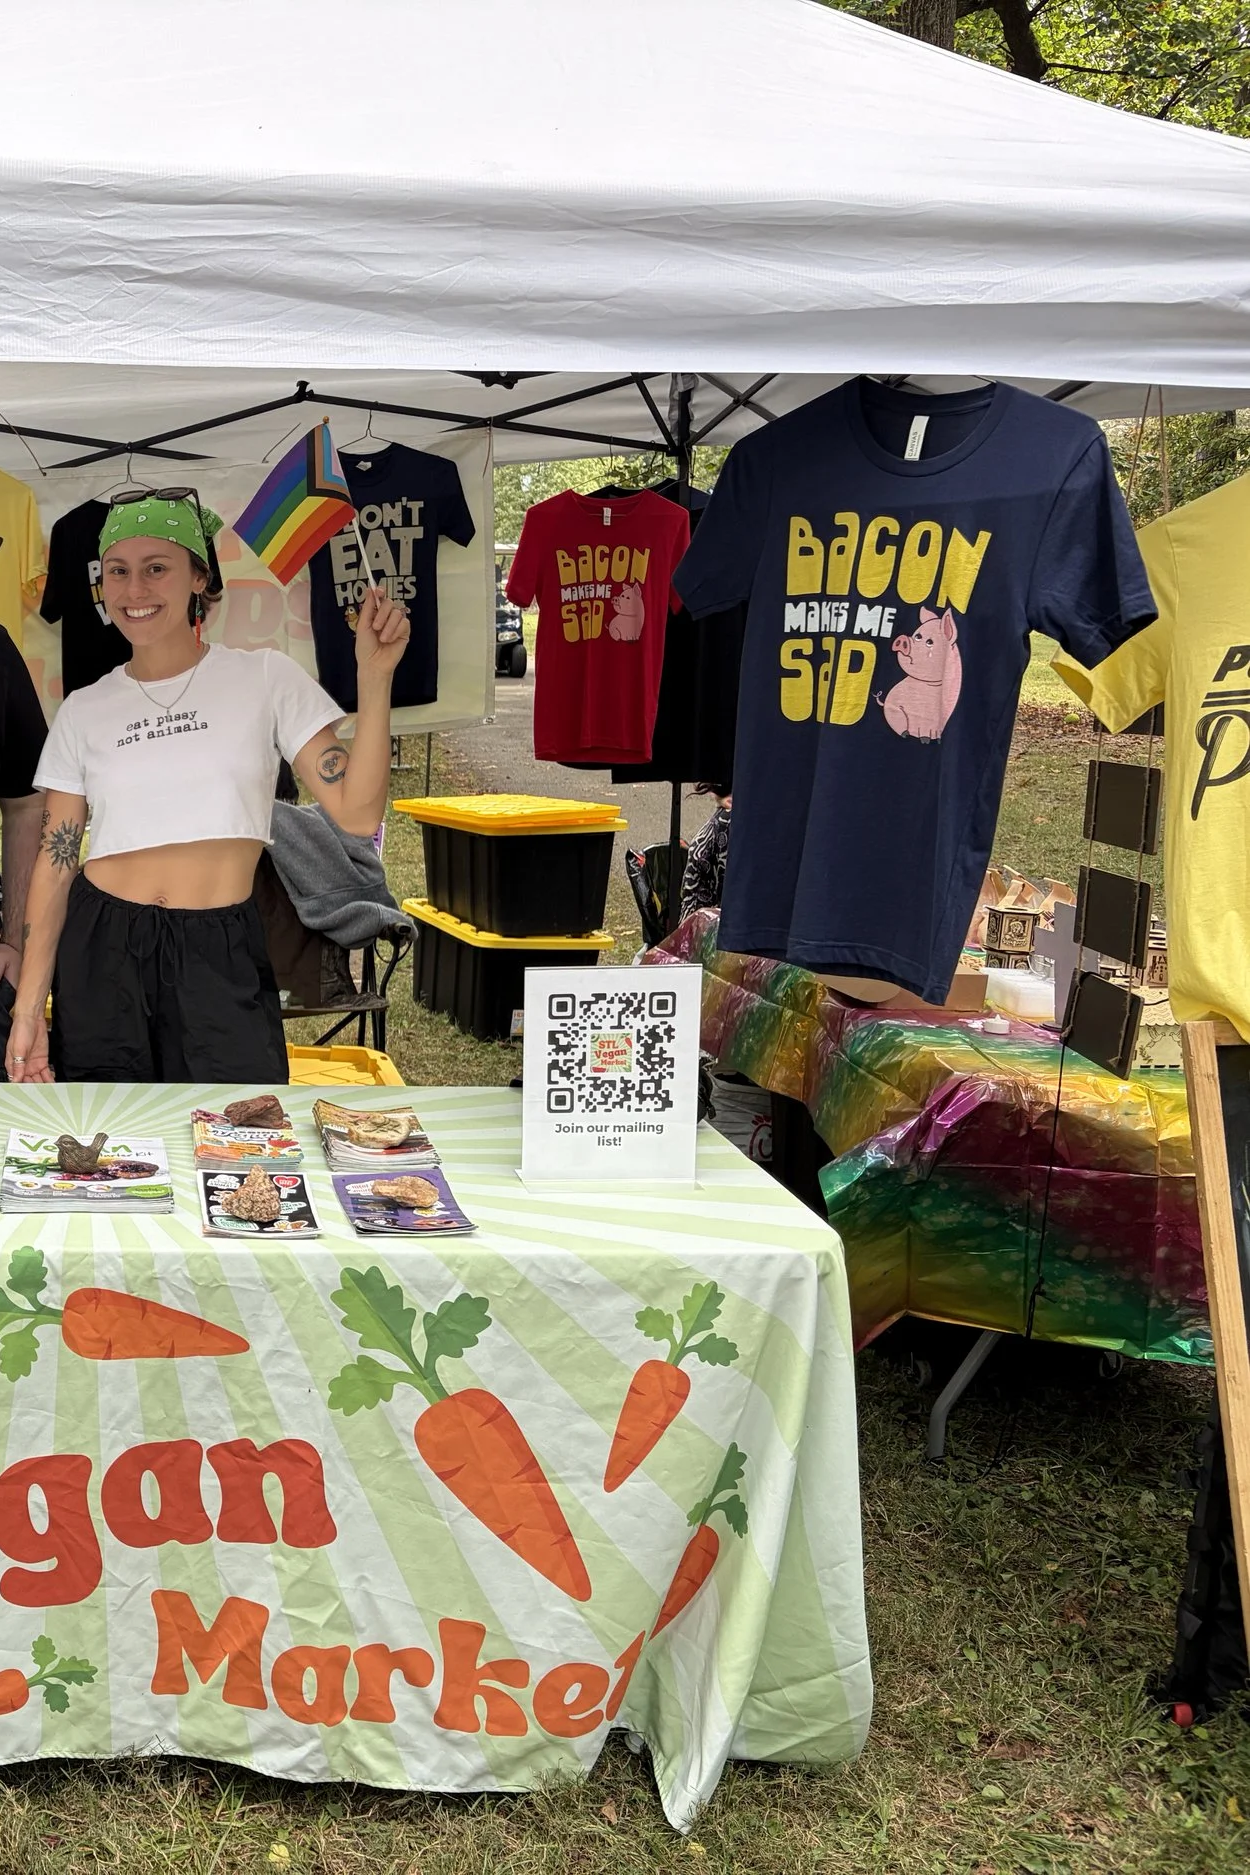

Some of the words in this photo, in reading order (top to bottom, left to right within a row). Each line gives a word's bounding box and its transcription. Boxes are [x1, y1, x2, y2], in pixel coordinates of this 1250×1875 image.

[330, 527, 424, 584] EAT
[595, 584, 612, 599] ME
[852, 603, 898, 639] ME
[126, 718, 150, 731] eat
[156, 710, 198, 727] pussy
[116, 733, 141, 748] not
[146, 720, 209, 740] animals
[598, 1040, 619, 1049] STL
[594, 1049, 627, 1060] Vegan
[554, 1123, 583, 1133] Join
[586, 1124, 610, 1133] our
[612, 1121, 664, 1134] mailing
[19, 1138, 133, 1153] Ven
[597, 1136, 622, 1146] list!
